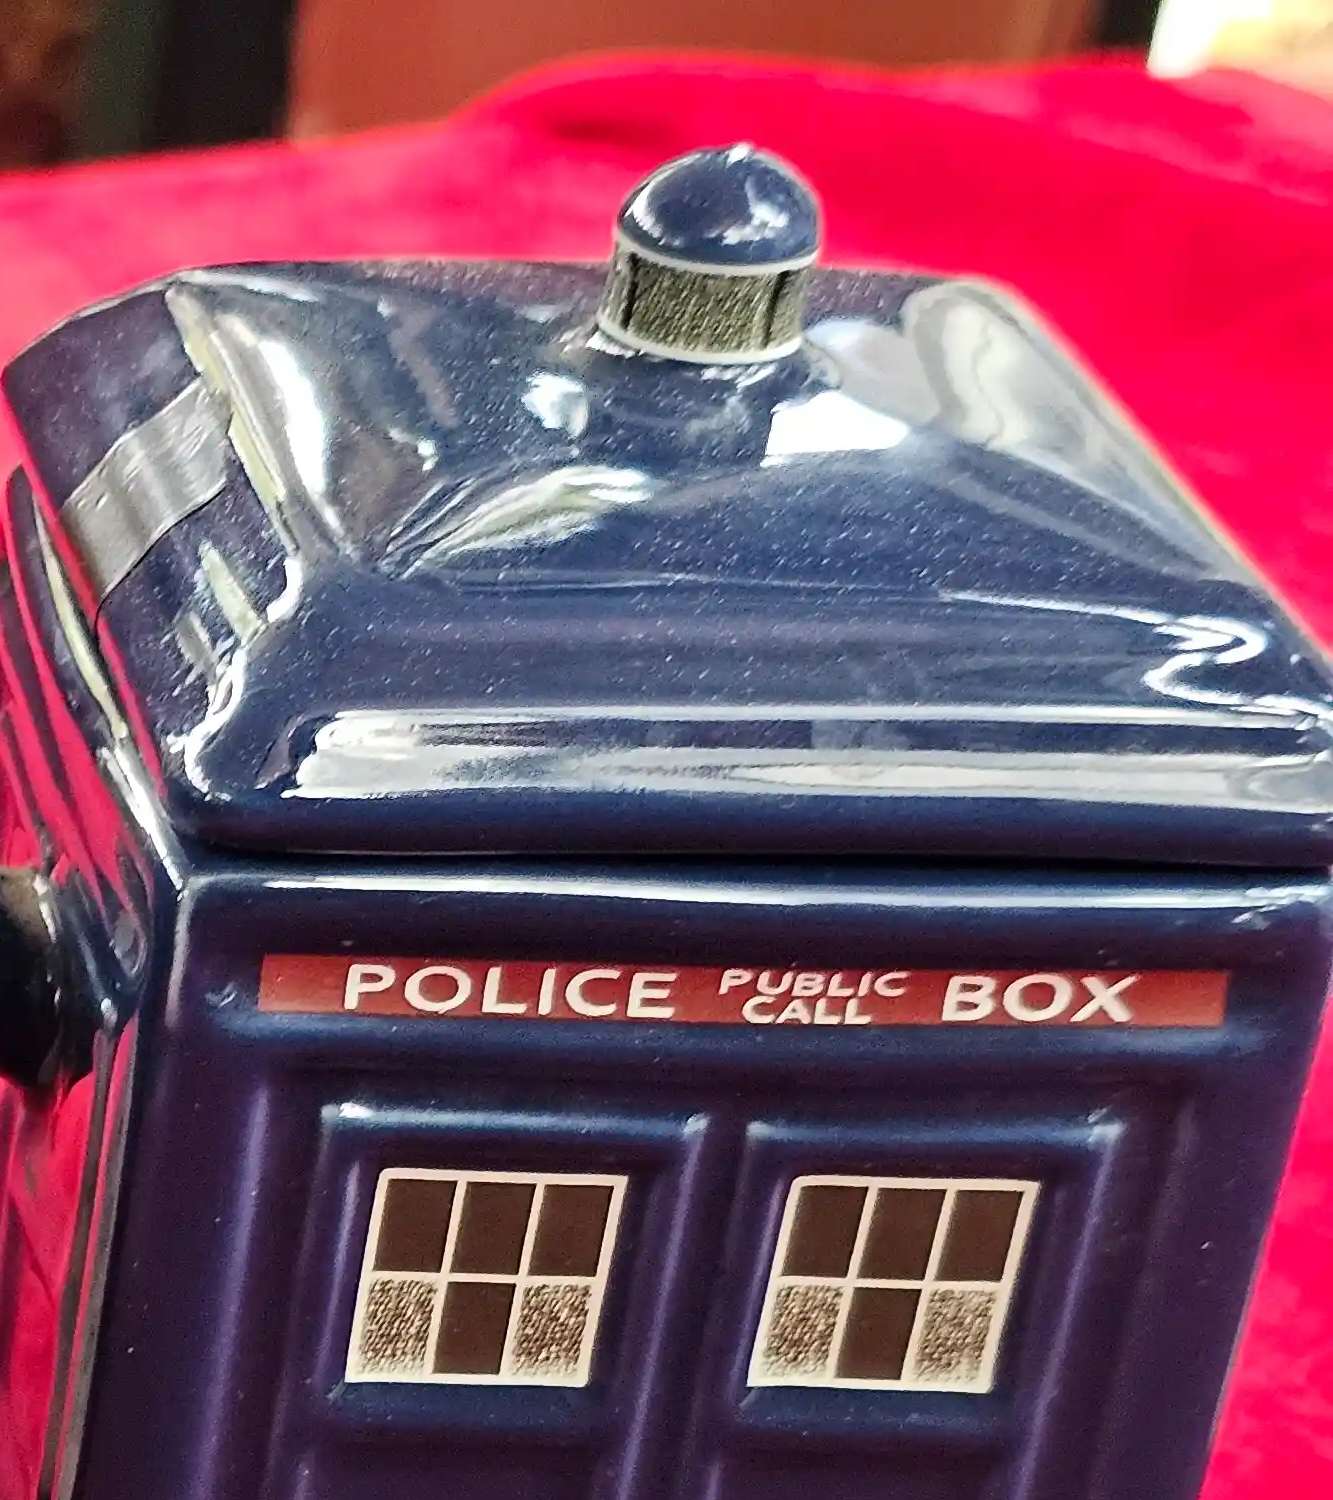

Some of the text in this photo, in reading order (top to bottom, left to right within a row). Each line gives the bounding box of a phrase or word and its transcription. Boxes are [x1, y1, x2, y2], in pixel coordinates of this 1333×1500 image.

[343, 964, 1141, 1026] POLICE PUBLIC CALL BOX
